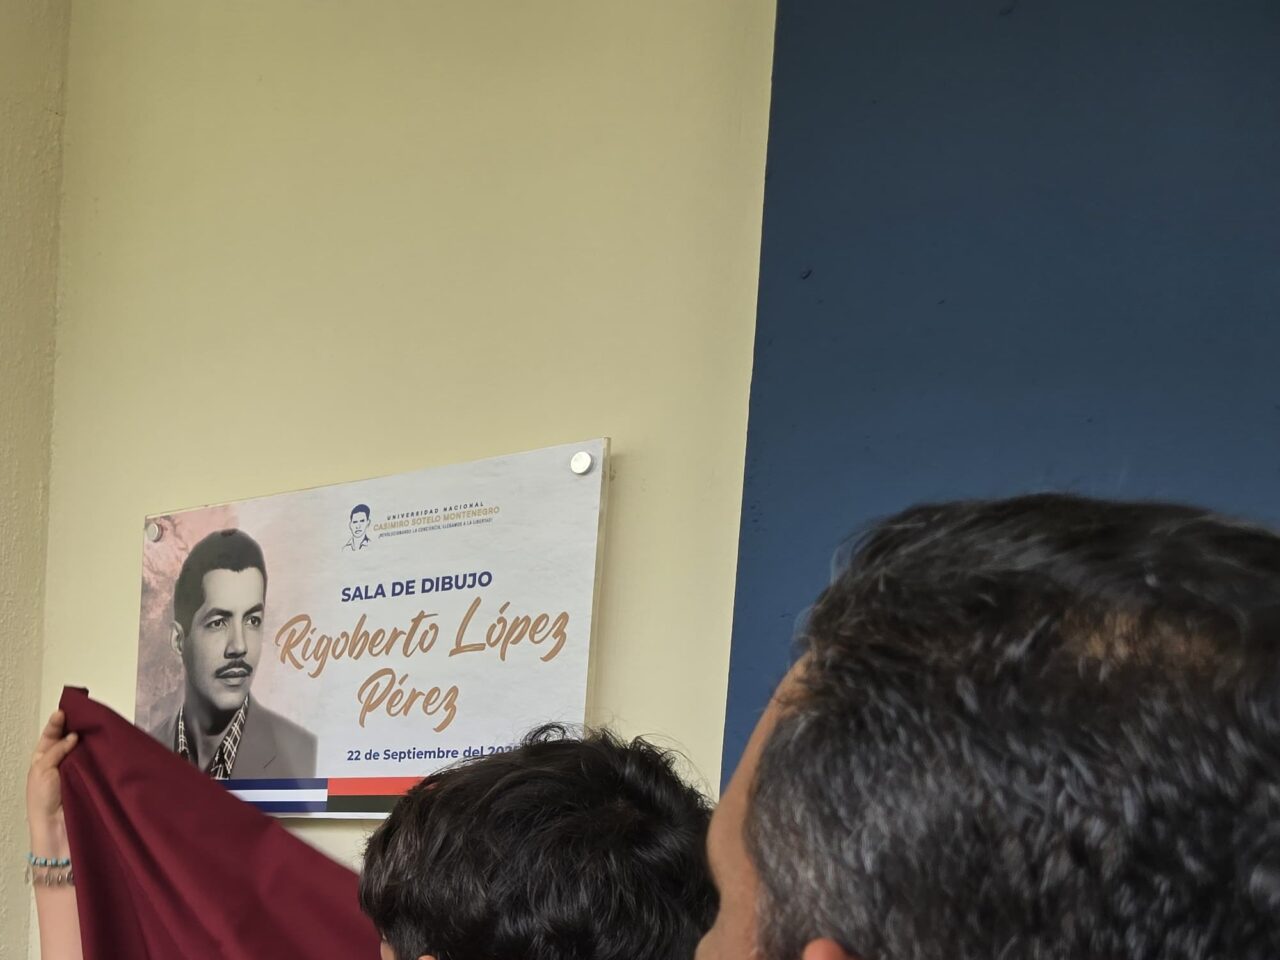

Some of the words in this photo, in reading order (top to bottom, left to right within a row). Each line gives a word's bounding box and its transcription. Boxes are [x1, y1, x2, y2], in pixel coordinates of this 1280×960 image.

[373, 519, 410, 531] CASIMIRO
[411, 515, 440, 526] SOTELO
[443, 506, 500, 521] MONTENEGRO
[387, 508, 439, 520] UNIVERSIDAD
[443, 501, 484, 512] NACIONAL
[341, 583, 386, 602] SALA
[391, 580, 416, 597] DE
[421, 571, 493, 594] DIBUJO
[274, 609, 439, 679] Rigoberto
[448, 596, 570, 663] López
[357, 667, 460, 733] Pérez
[347, 750, 361, 761] 22
[364, 749, 380, 760] de
[383, 747, 459, 763] Septiembre
[463, 746, 484, 759] del
